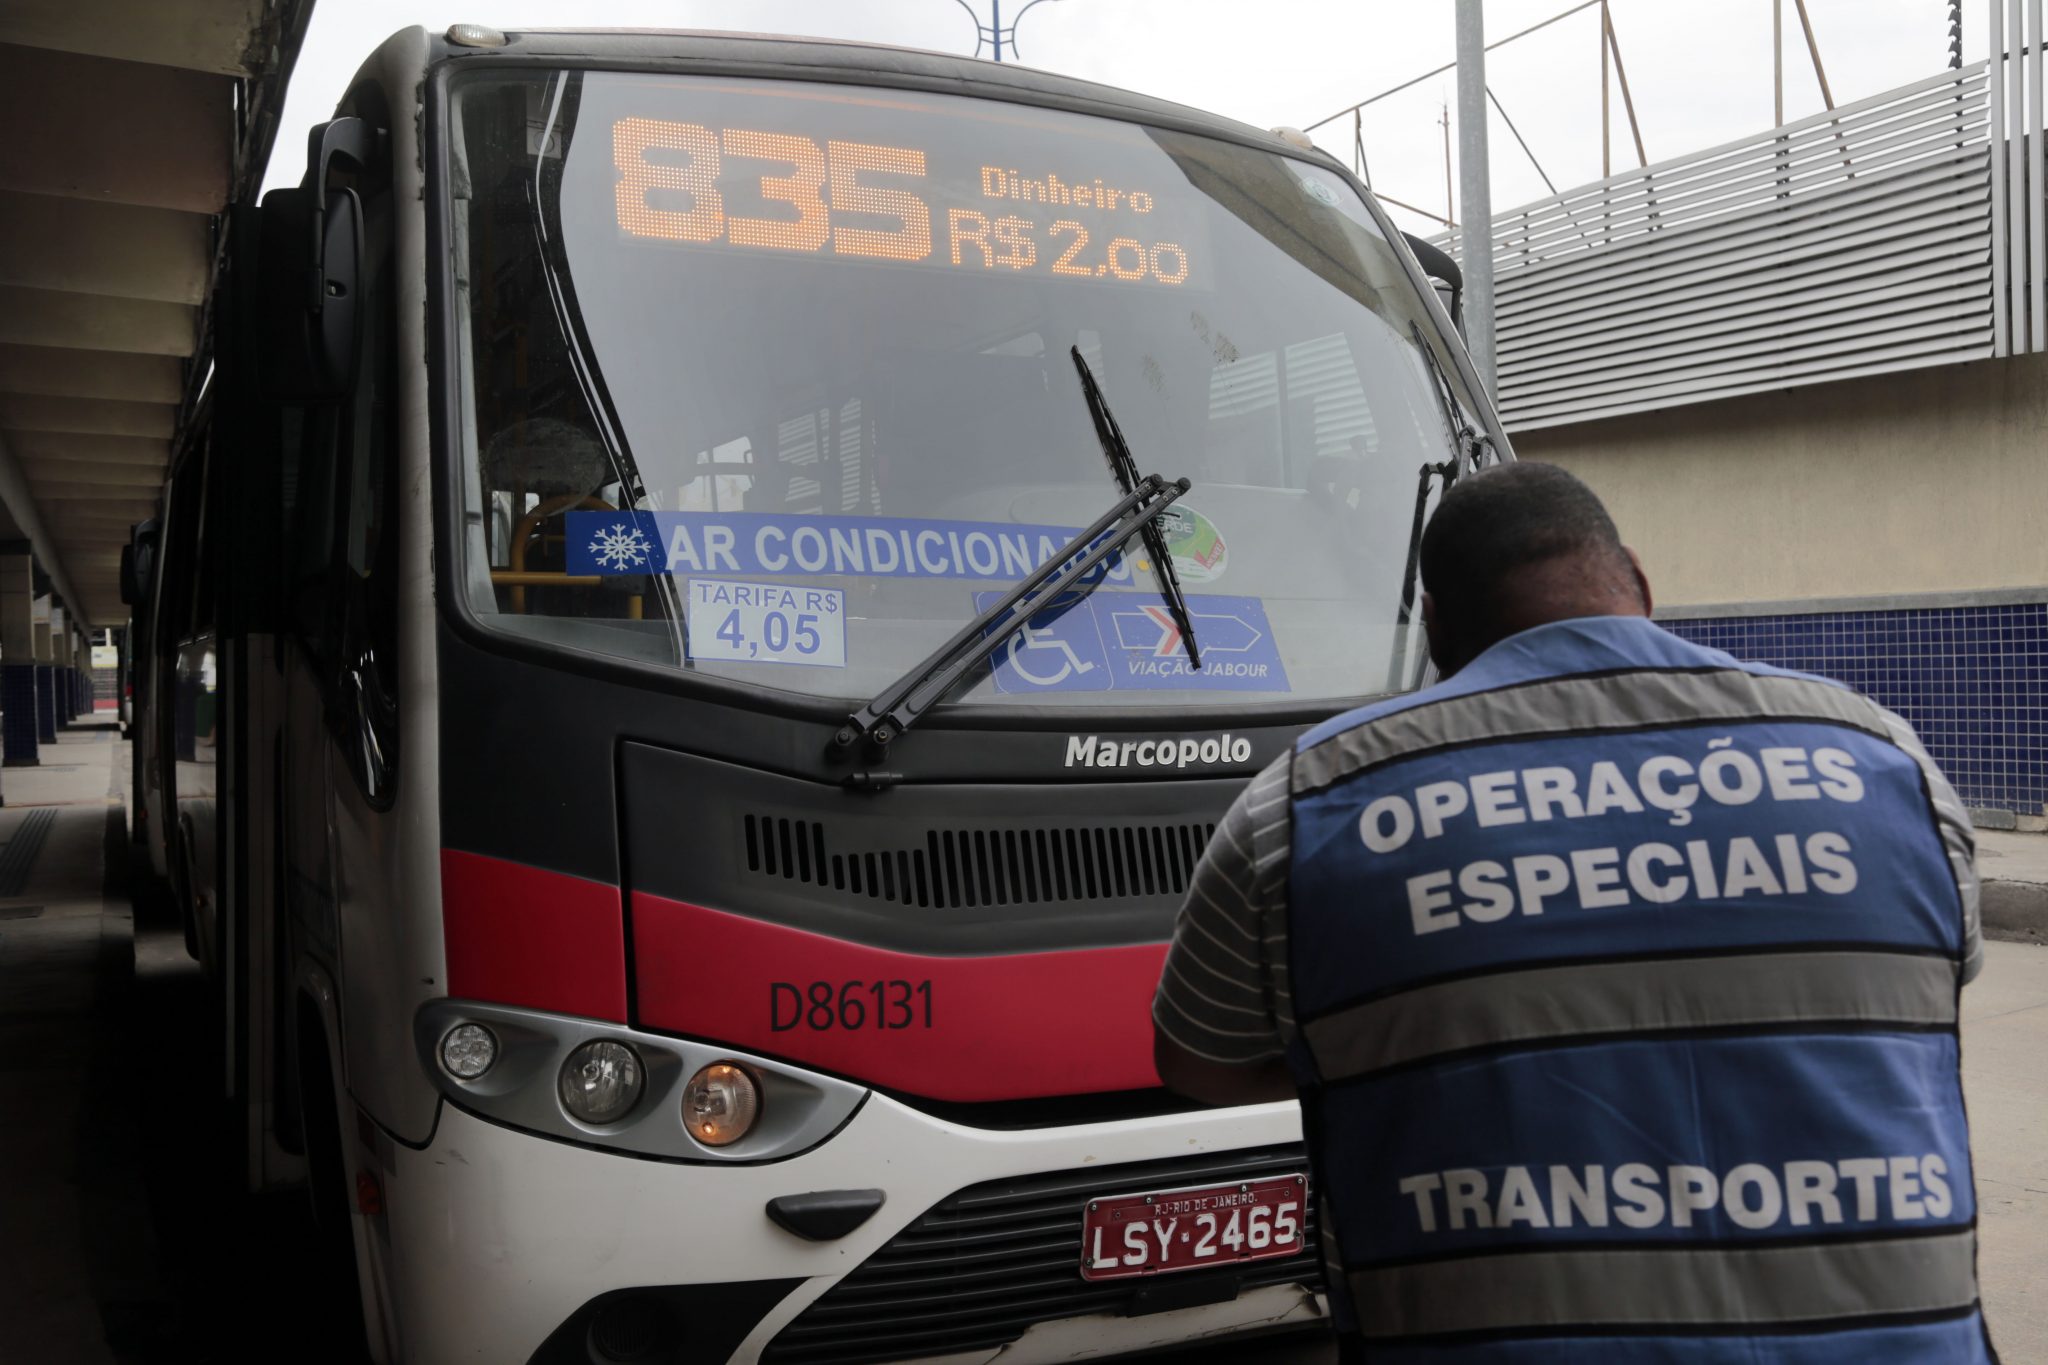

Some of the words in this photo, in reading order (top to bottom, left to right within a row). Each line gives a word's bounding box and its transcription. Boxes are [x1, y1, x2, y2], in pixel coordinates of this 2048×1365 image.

[612, 116, 932, 262] 835
[980, 165, 1154, 214] Dinheiro
[948, 208, 1036, 269] R$
[666, 525, 740, 571] AR
[697, 583, 798, 610] TARIFA
[805, 592, 838, 613] R$
[716, 608, 821, 658] 4,05
[1128, 658, 1198, 678] VIAÇÃO
[1203, 662, 1268, 678] JABOUR
[1064, 733, 1252, 769] Marcopolo
[1359, 736, 1866, 855] OPERAÇÕES
[1405, 832, 1859, 936] ESPECIAIS
[770, 980, 932, 1032] D86131
[1194, 1199, 1208, 1212] DE
[1400, 1153, 1954, 1233] TRANSPORTES
